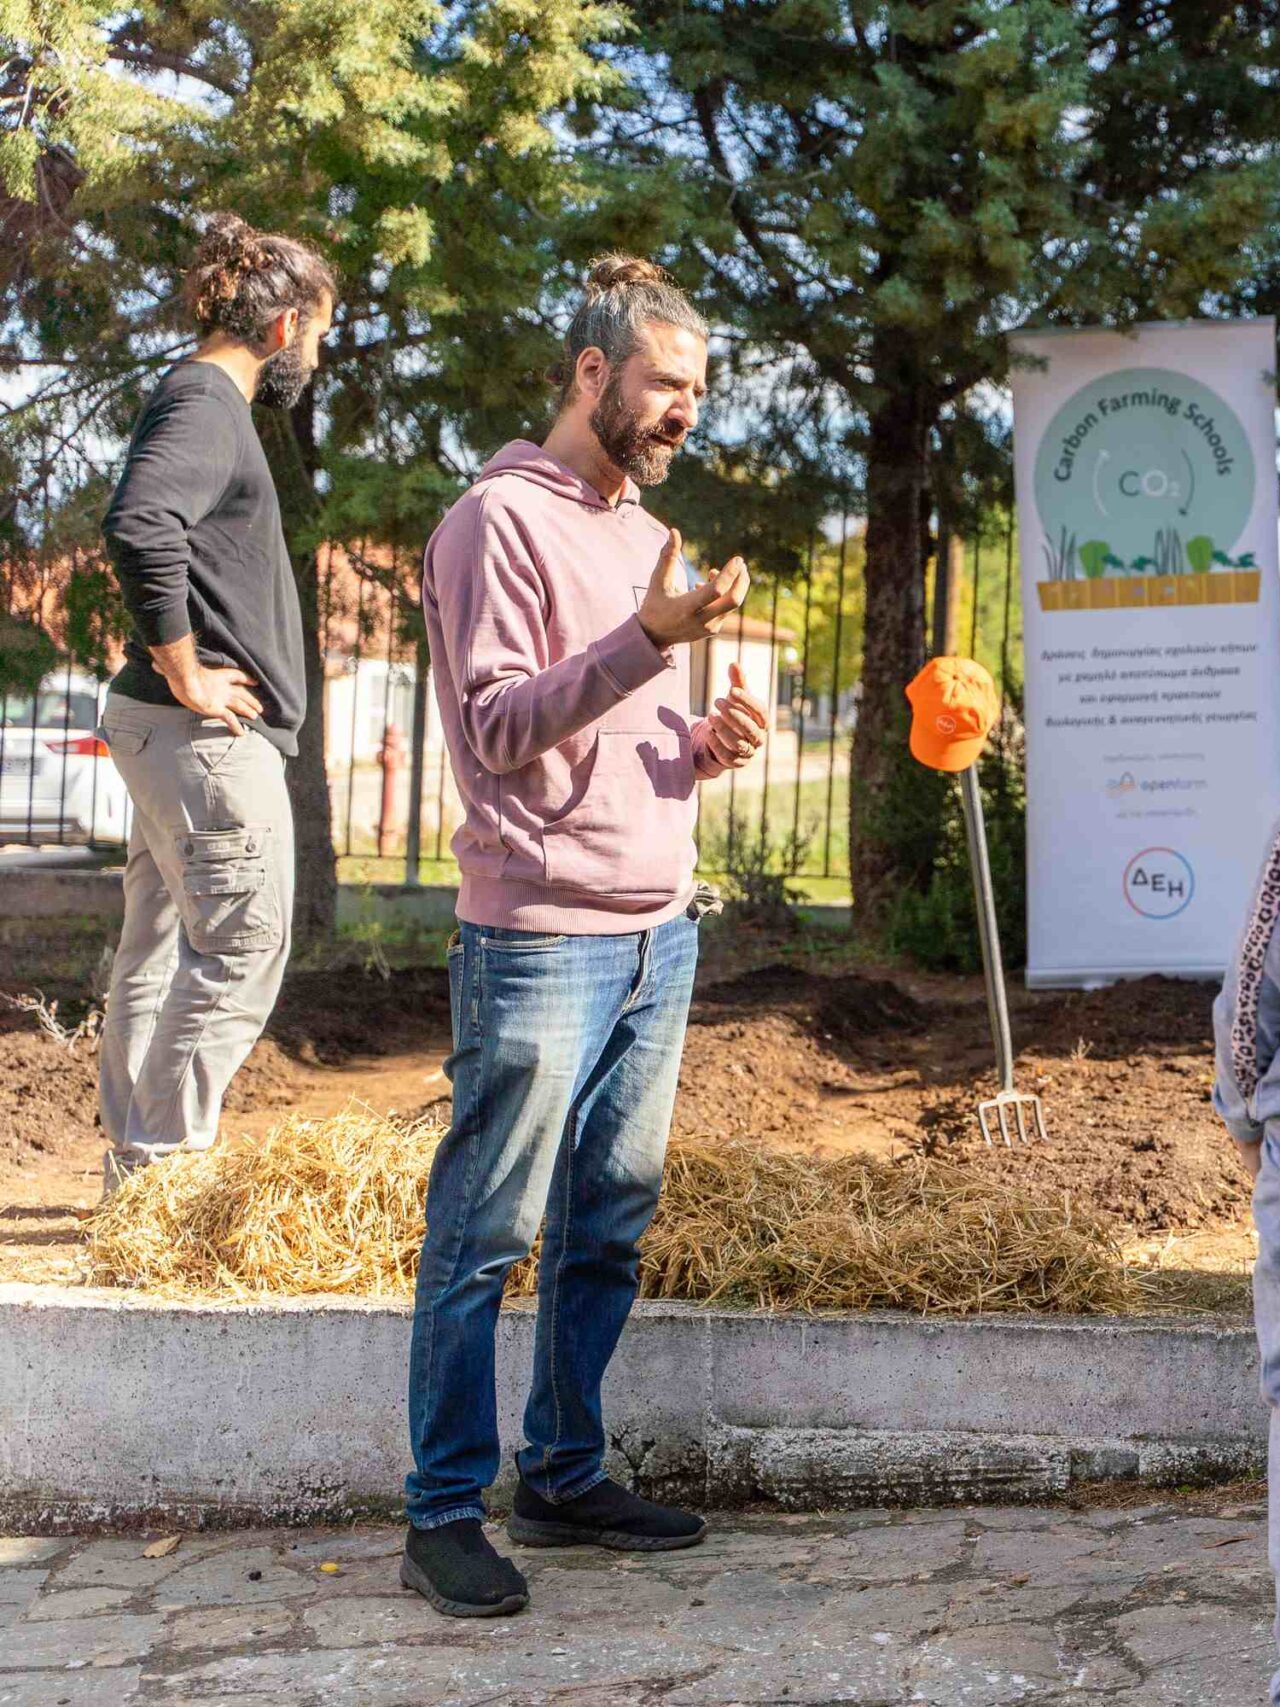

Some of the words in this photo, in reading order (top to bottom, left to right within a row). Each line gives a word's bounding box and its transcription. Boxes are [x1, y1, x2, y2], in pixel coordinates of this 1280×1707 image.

[1054, 411, 1099, 482] Carbon
[1098, 388, 1181, 417] Farming
[1183, 402, 1234, 477] Schools
